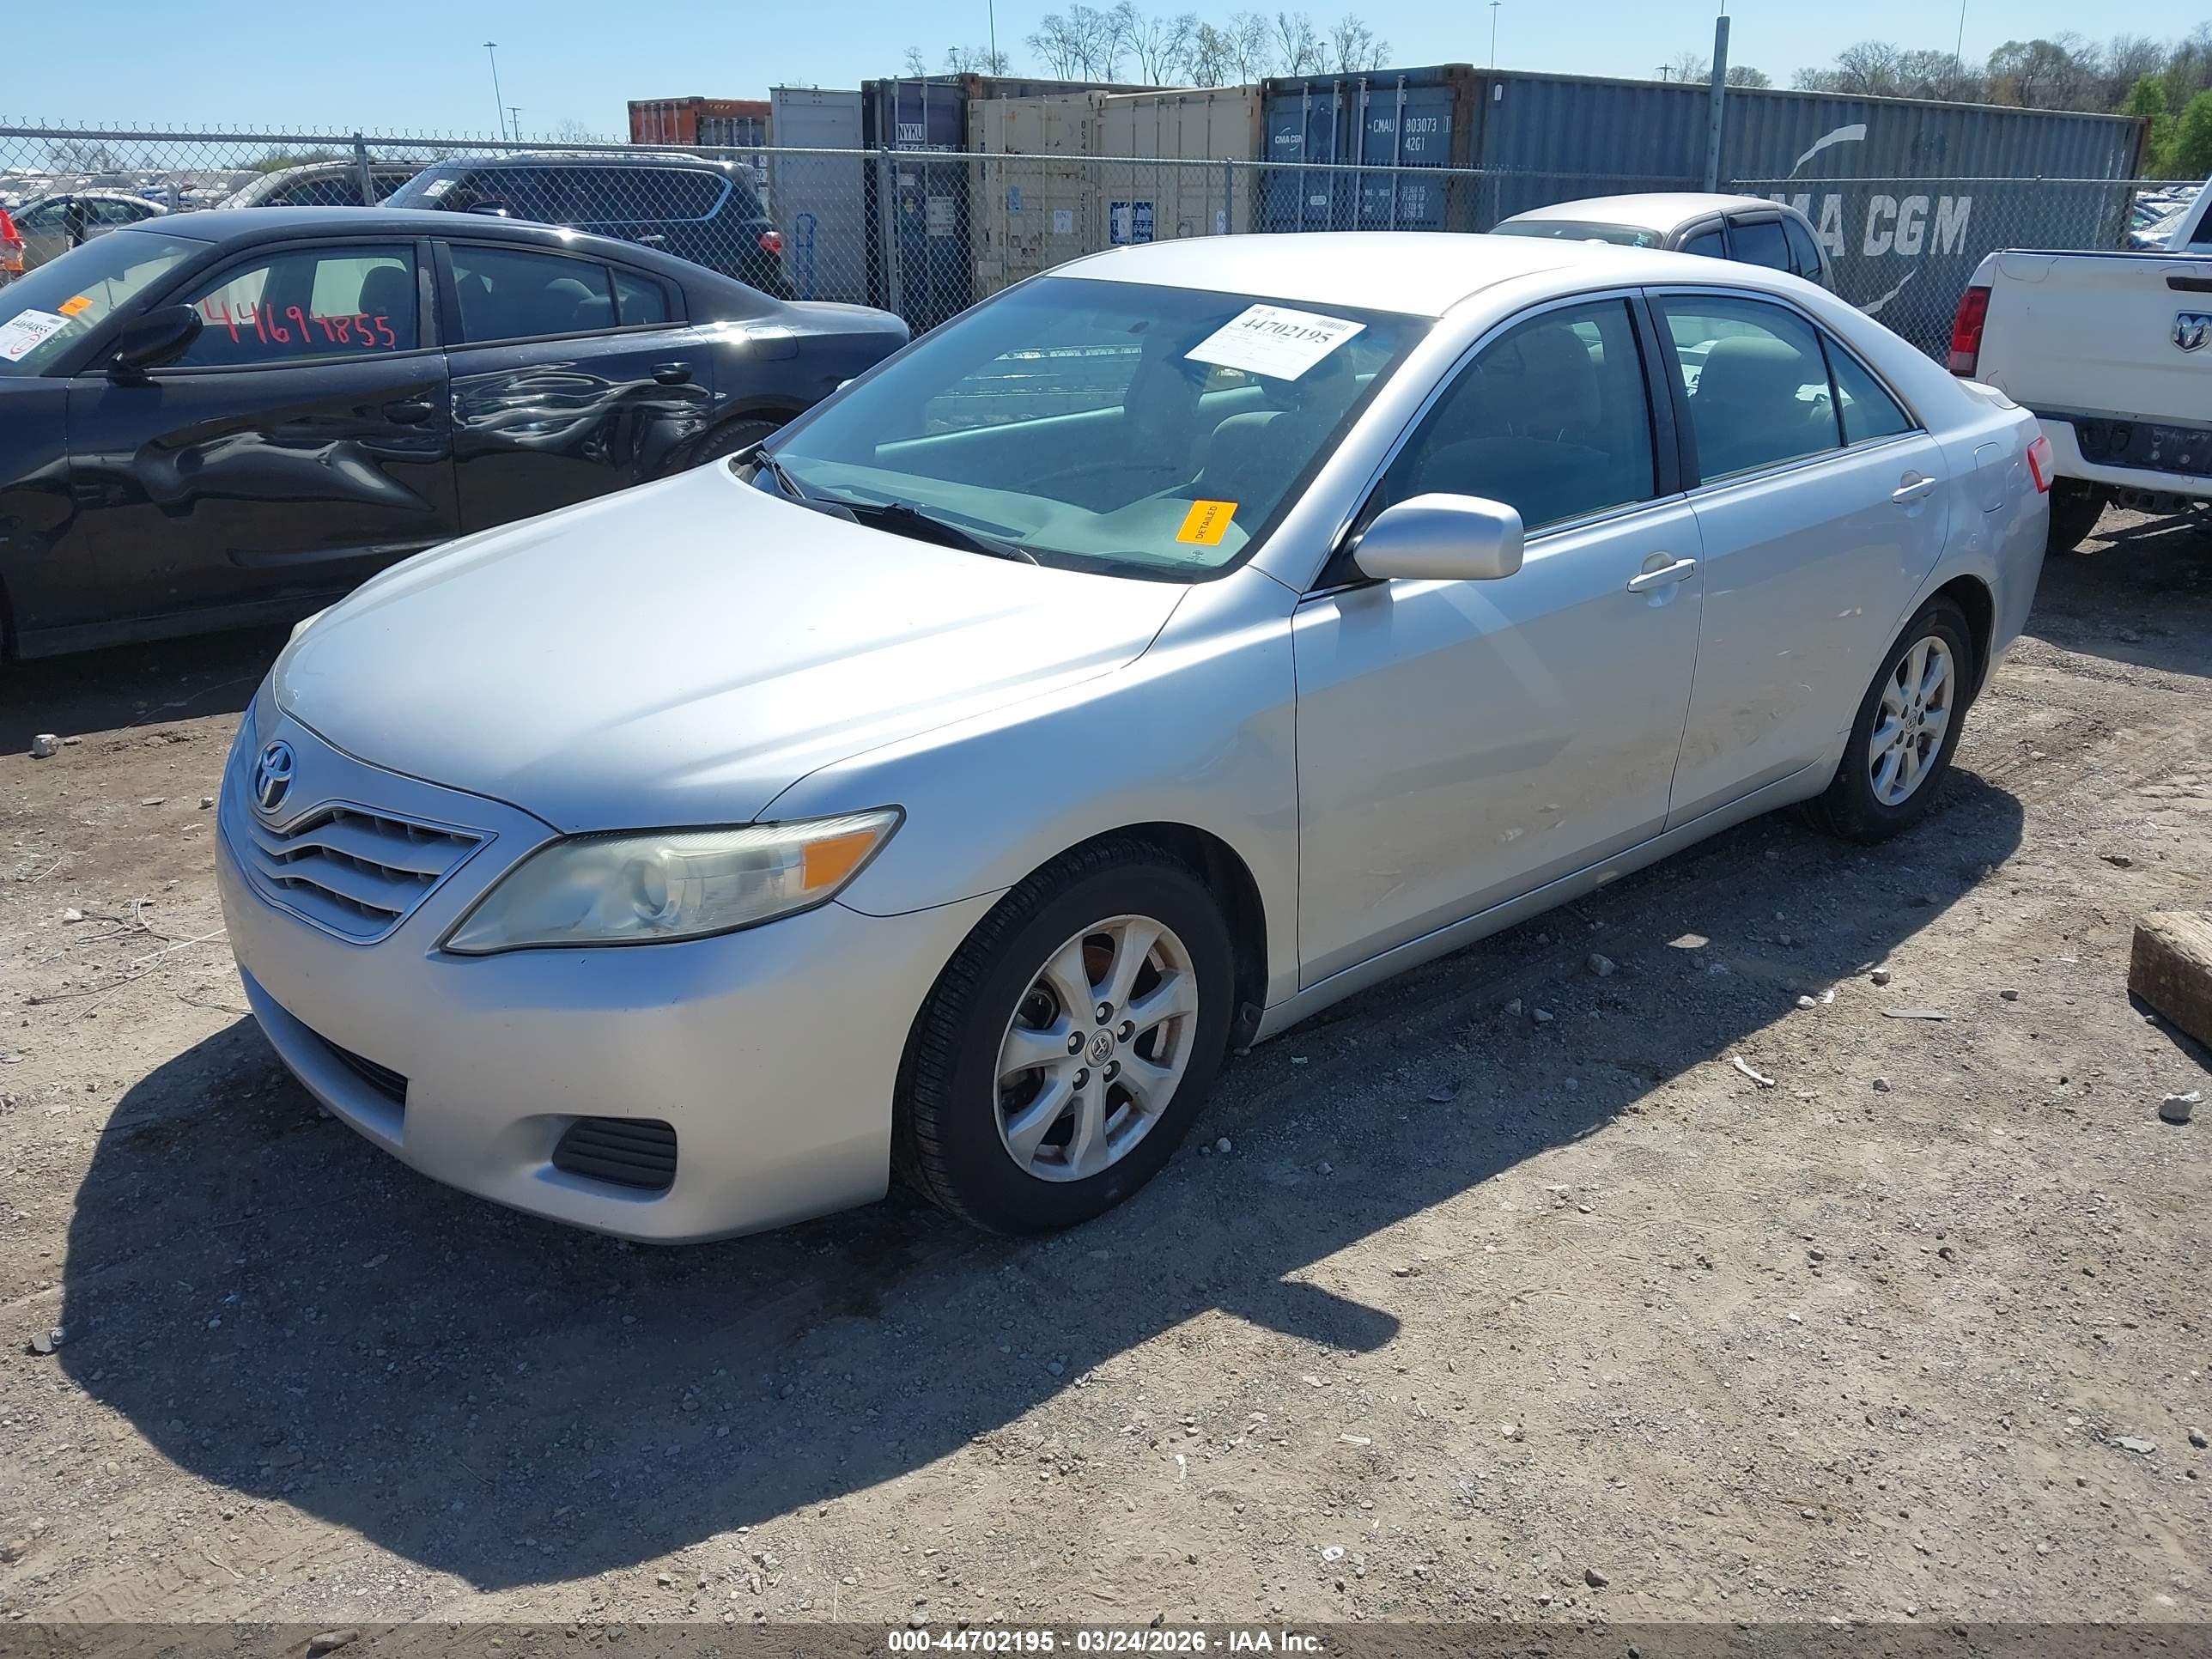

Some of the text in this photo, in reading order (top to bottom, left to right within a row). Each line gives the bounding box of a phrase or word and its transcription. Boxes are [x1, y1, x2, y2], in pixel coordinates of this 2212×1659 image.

[898, 123, 924, 141] NYKU
[1373, 118, 1395, 133] CMAU
[1405, 118, 1437, 133] 803073
[1274, 135, 1290, 144] CMA
[1405, 136, 1425, 151] 42G1
[1863, 194, 1972, 257] CGM
[1242, 318, 1335, 344] 44702195
[1195, 505, 1218, 539] DETAILED
